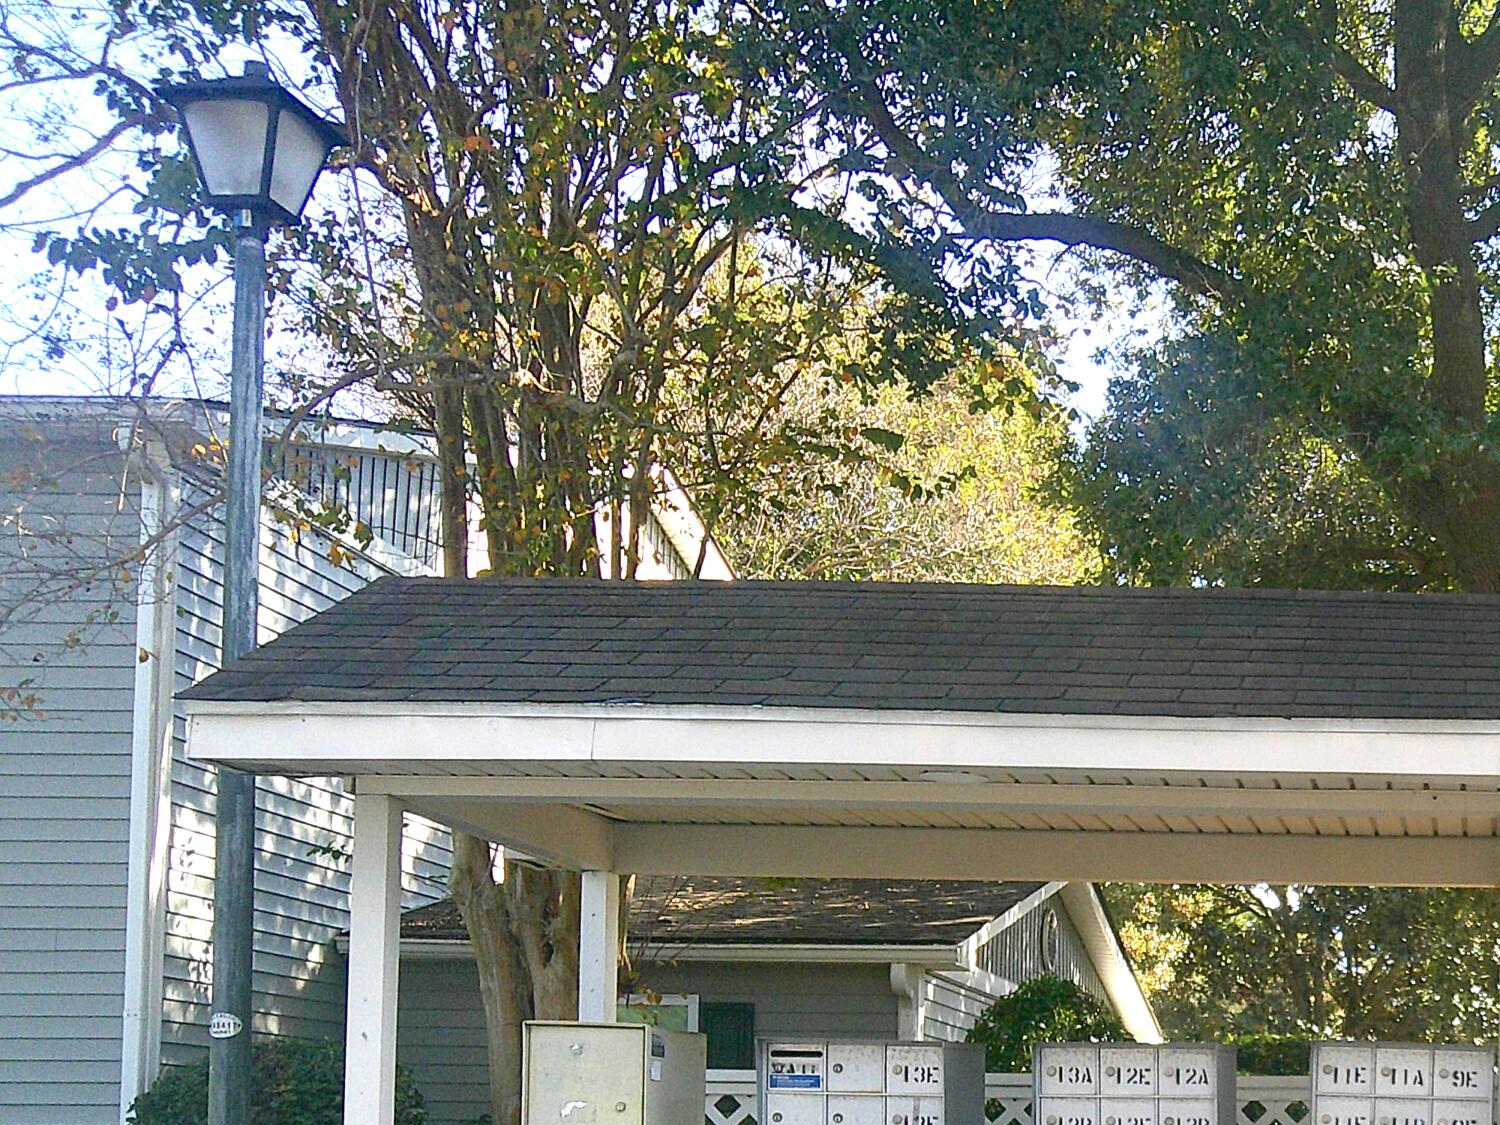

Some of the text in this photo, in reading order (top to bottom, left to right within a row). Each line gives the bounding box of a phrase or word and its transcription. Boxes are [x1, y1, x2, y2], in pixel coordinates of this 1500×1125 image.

[905, 1066, 939, 1083] 13E
[1059, 1067, 1092, 1083] 13A
[1117, 1068, 1151, 1085] 12E
[1176, 1068, 1208, 1085] 12A
[1334, 1067, 1366, 1084] 11E
[1392, 1068, 1423, 1086] 11A
[1453, 1071, 1477, 1087] 9E
